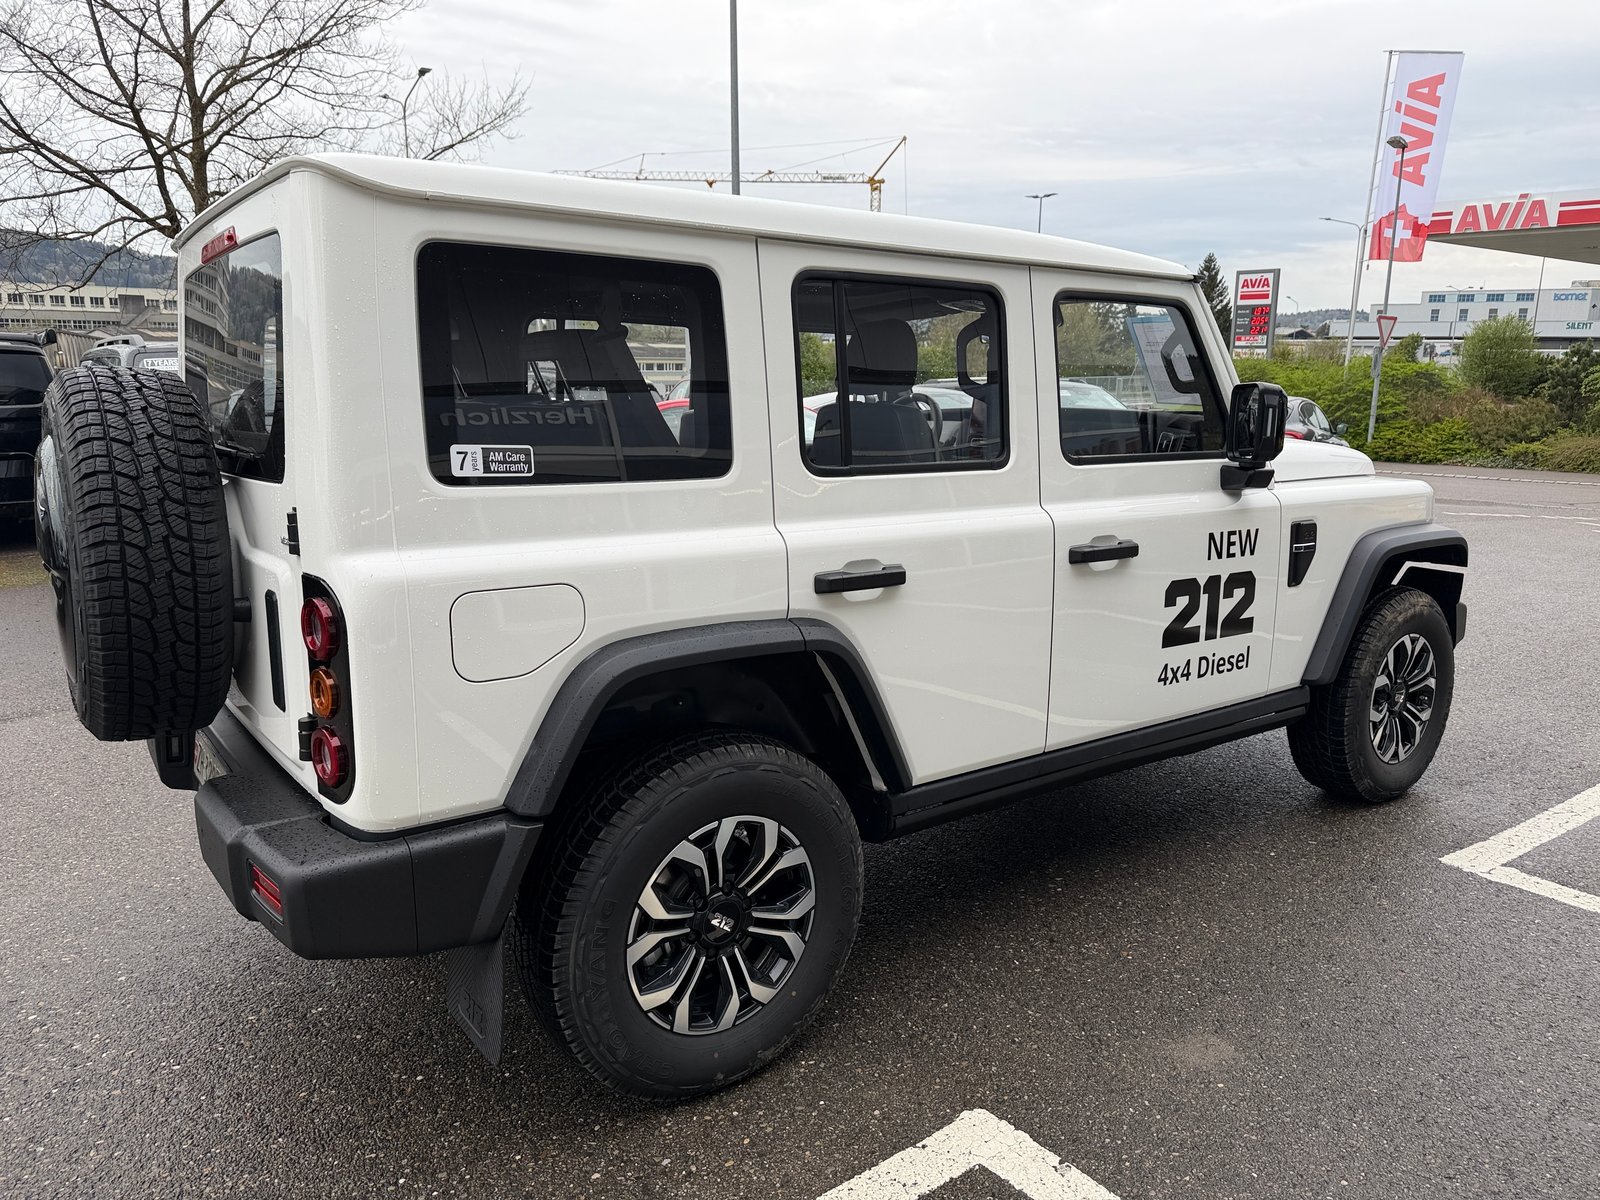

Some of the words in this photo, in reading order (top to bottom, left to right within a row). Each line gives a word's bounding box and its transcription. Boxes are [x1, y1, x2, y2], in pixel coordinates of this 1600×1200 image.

[1566, 322, 1593, 330] SILENT
[456, 451, 469, 471] 7
[471, 451, 480, 472] years
[489, 452, 504, 462] AM
[506, 452, 526, 462] Care
[489, 462, 529, 473] Warranty
[1207, 528, 1260, 561] NEW
[1161, 570, 1257, 649] 212
[1157, 658, 1192, 687] 4x4
[1197, 645, 1251, 679] Diesel
[711, 912, 735, 932] 212
